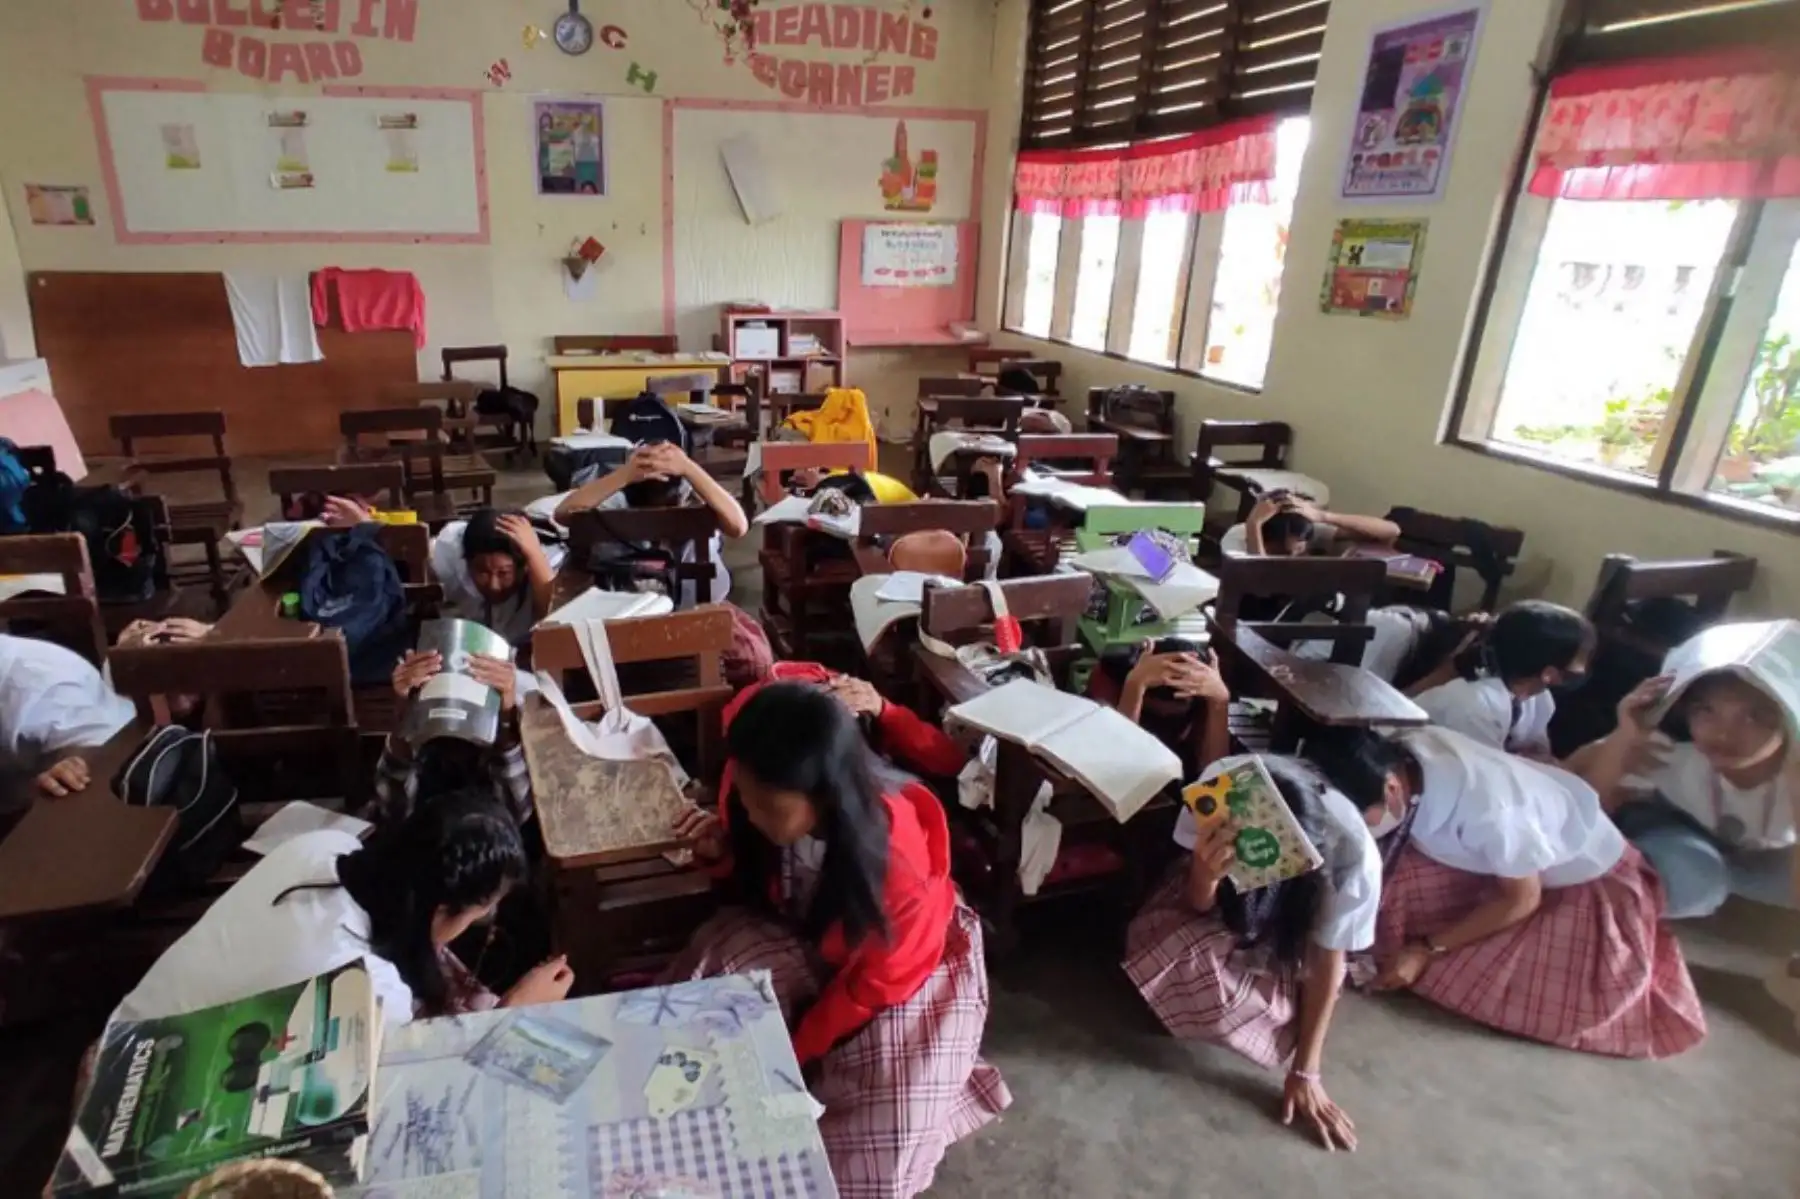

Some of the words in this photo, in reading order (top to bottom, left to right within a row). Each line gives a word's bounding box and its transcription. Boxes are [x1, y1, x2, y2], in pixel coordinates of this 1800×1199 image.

[201, 28, 363, 83] BOARD
[750, 4, 938, 61] READING
[749, 53, 915, 105] CORNER
[101, 1037, 154, 1159] MATHEMATICS
